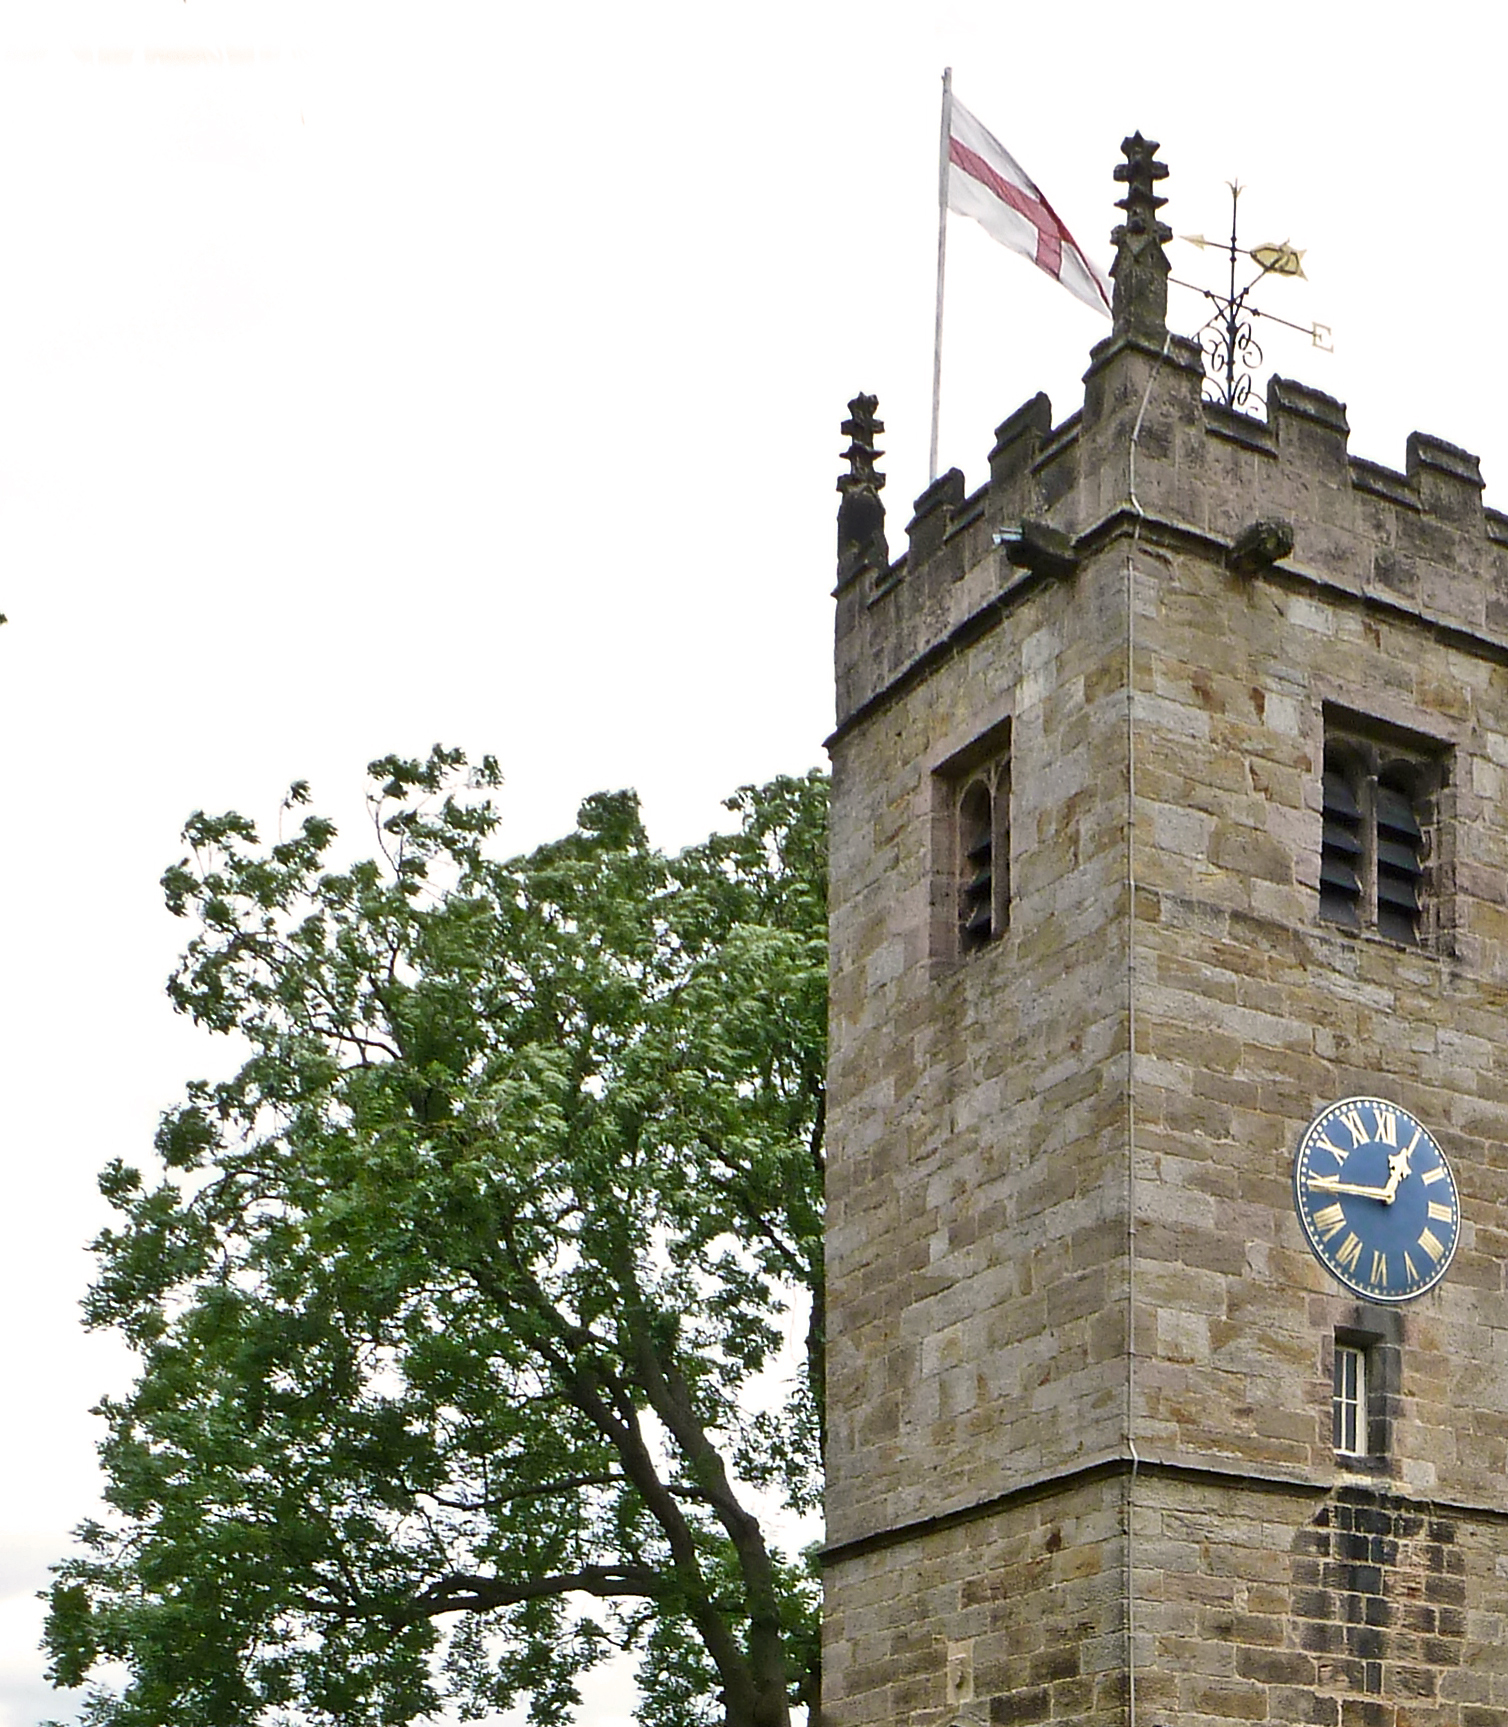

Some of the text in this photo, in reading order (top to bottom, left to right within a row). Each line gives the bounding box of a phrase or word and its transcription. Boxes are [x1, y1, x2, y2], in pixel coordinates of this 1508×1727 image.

[1312, 321, 1334, 353] E
[1339, 1110, 1371, 1149] XI
[1373, 1109, 1397, 1147] XII
[1315, 1133, 1350, 1167] X
[1421, 1166, 1445, 1186] II
[1313, 1202, 1347, 1243] VIII
[1428, 1201, 1452, 1223] III
[1335, 1231, 1363, 1273] VII
[1370, 1250, 1388, 1287] VI
[1404, 1250, 1419, 1284] V
